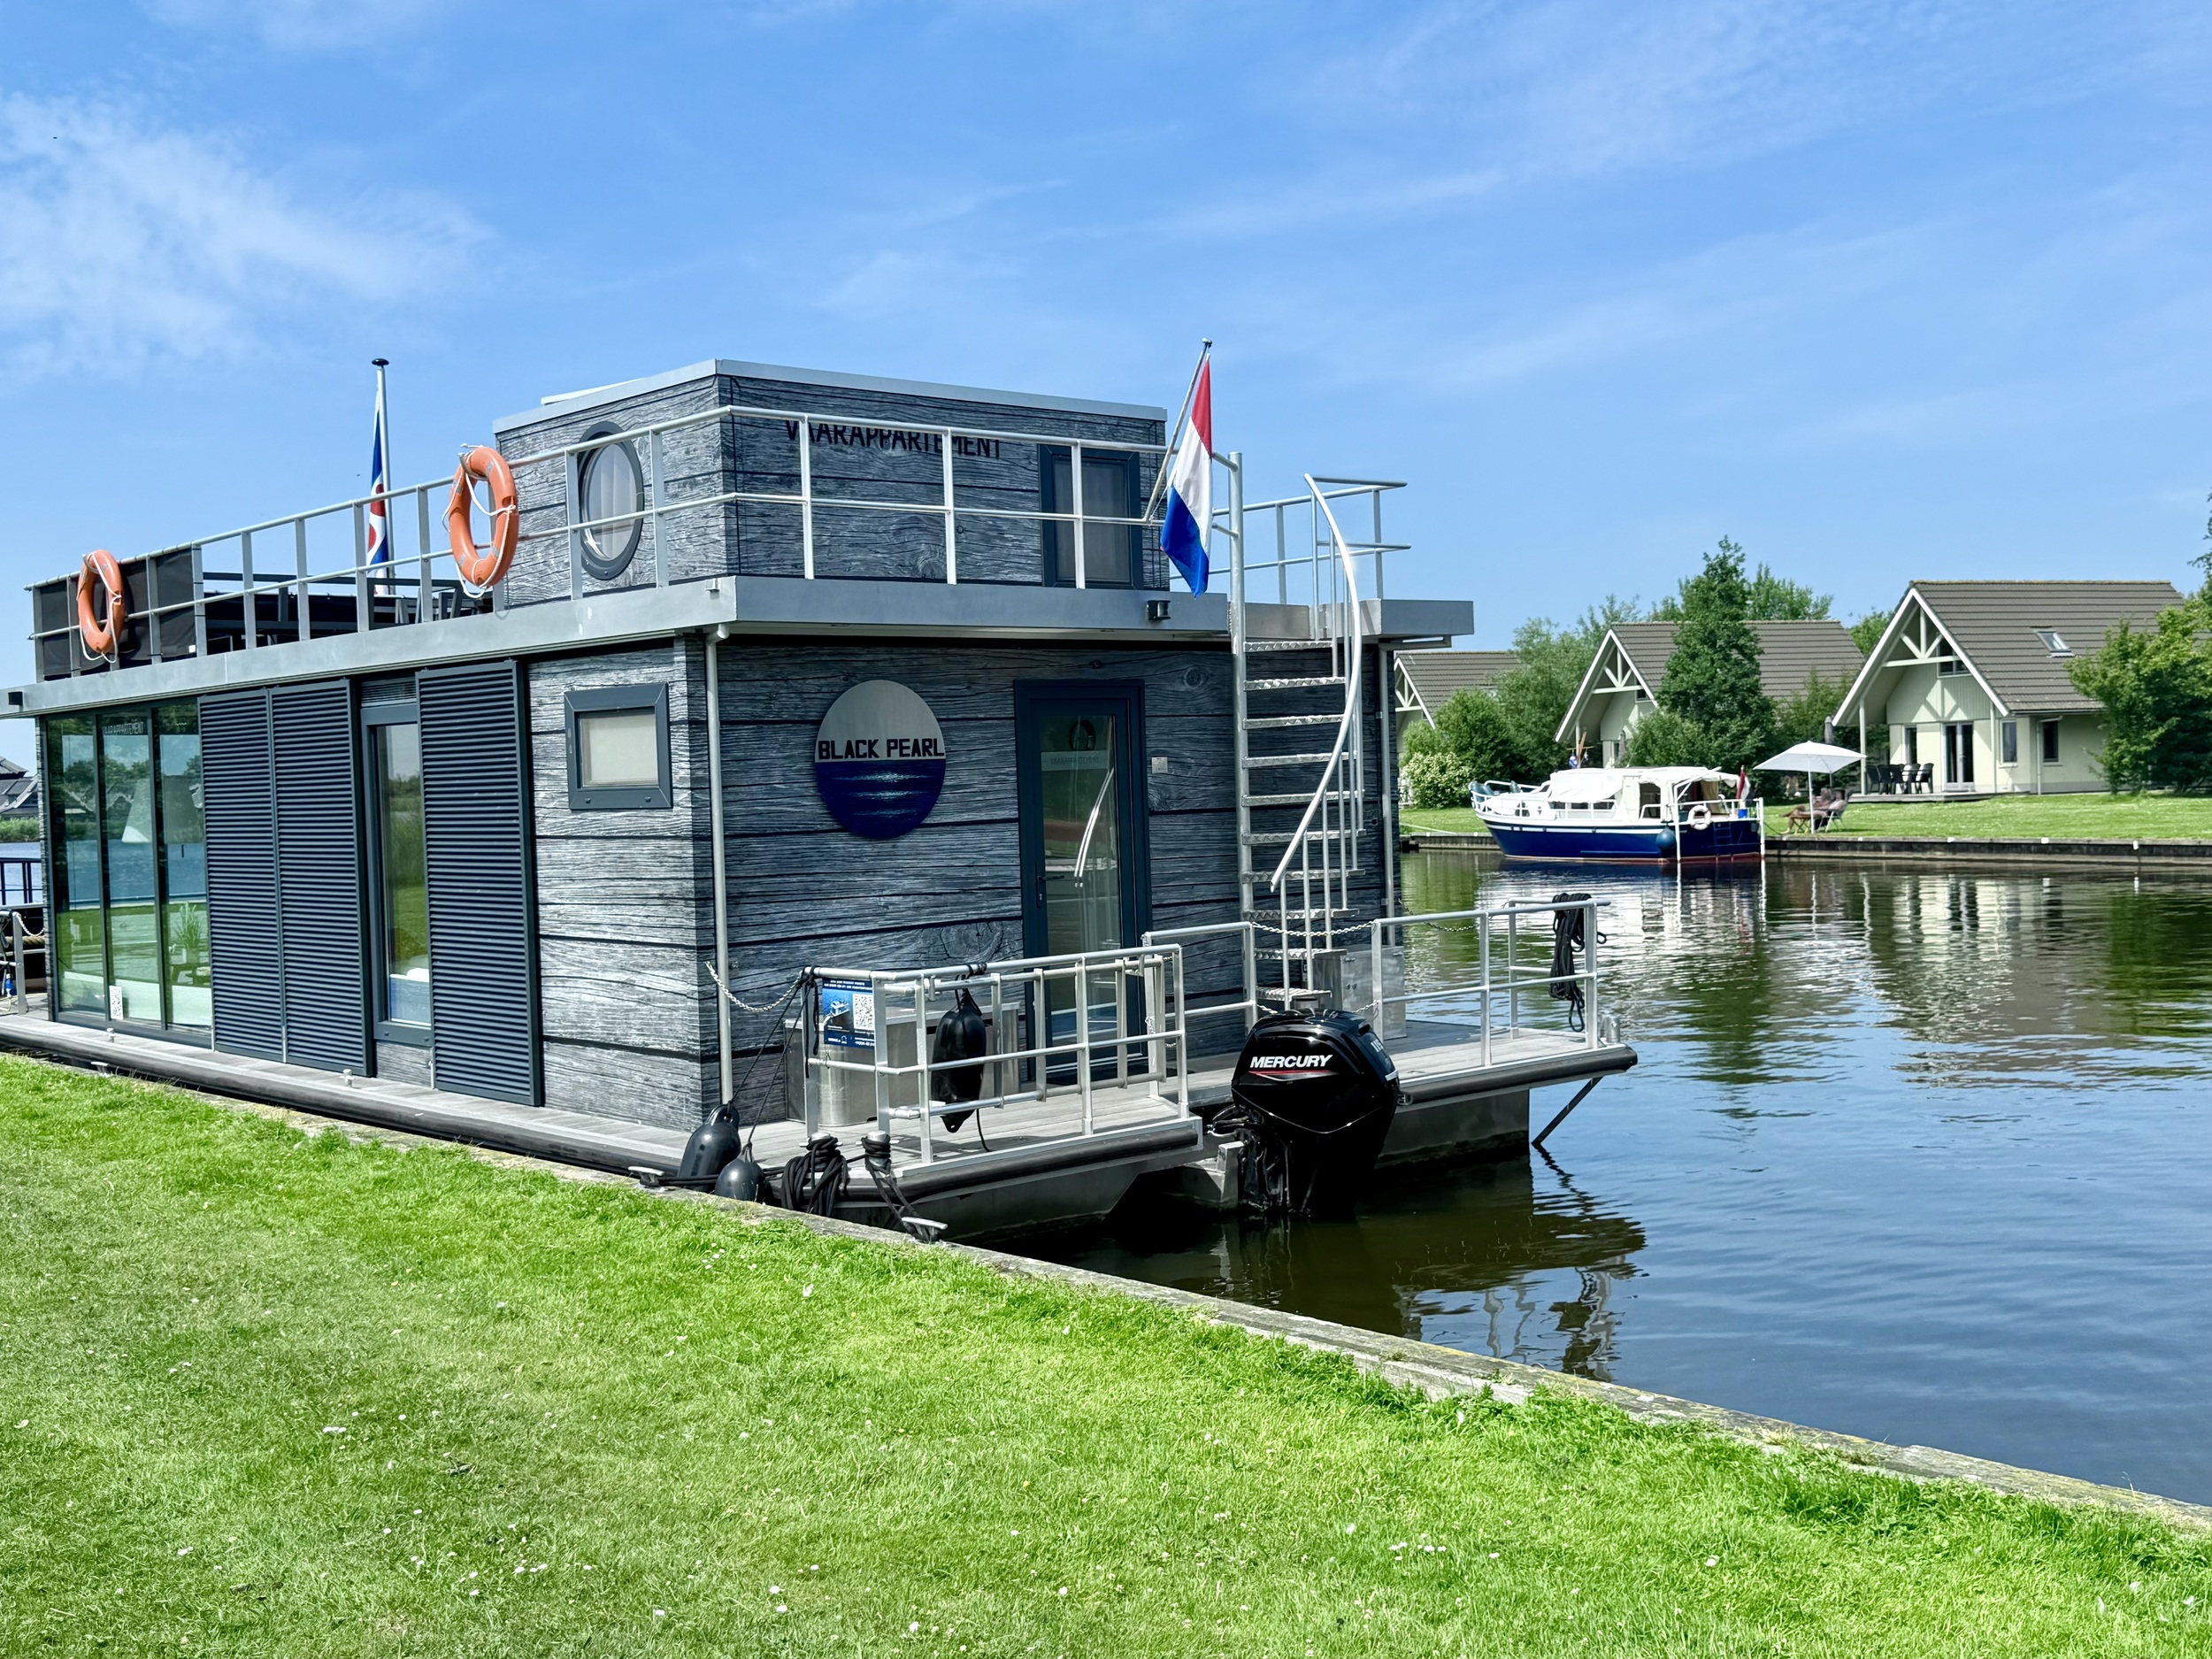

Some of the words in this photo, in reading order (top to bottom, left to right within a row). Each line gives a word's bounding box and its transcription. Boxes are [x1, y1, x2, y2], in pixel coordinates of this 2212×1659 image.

[818, 739, 880, 760] BLACK
[887, 738, 945, 758] PEARL
[1249, 1054, 1333, 1069] MERCURY
